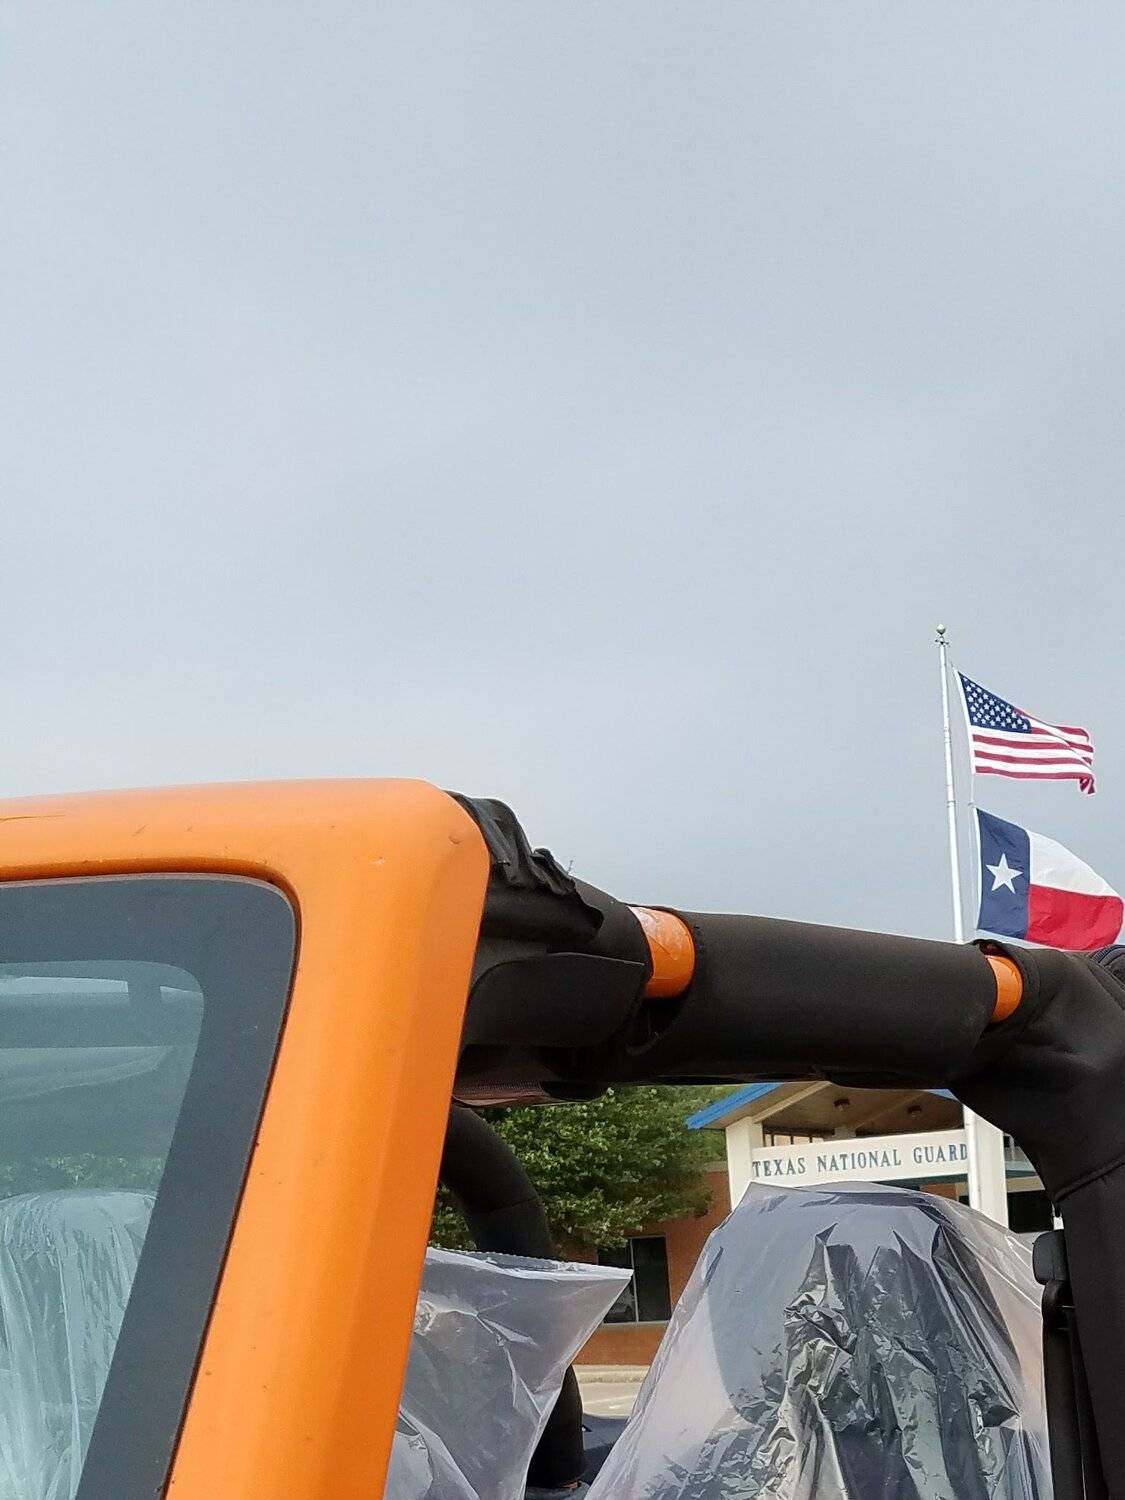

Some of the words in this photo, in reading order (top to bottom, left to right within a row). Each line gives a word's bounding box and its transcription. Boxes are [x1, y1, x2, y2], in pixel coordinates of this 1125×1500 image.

[752, 1157, 806, 1177] TEXAS
[817, 1149, 902, 1172] NATIONAL
[913, 1143, 968, 1164] GUARD
